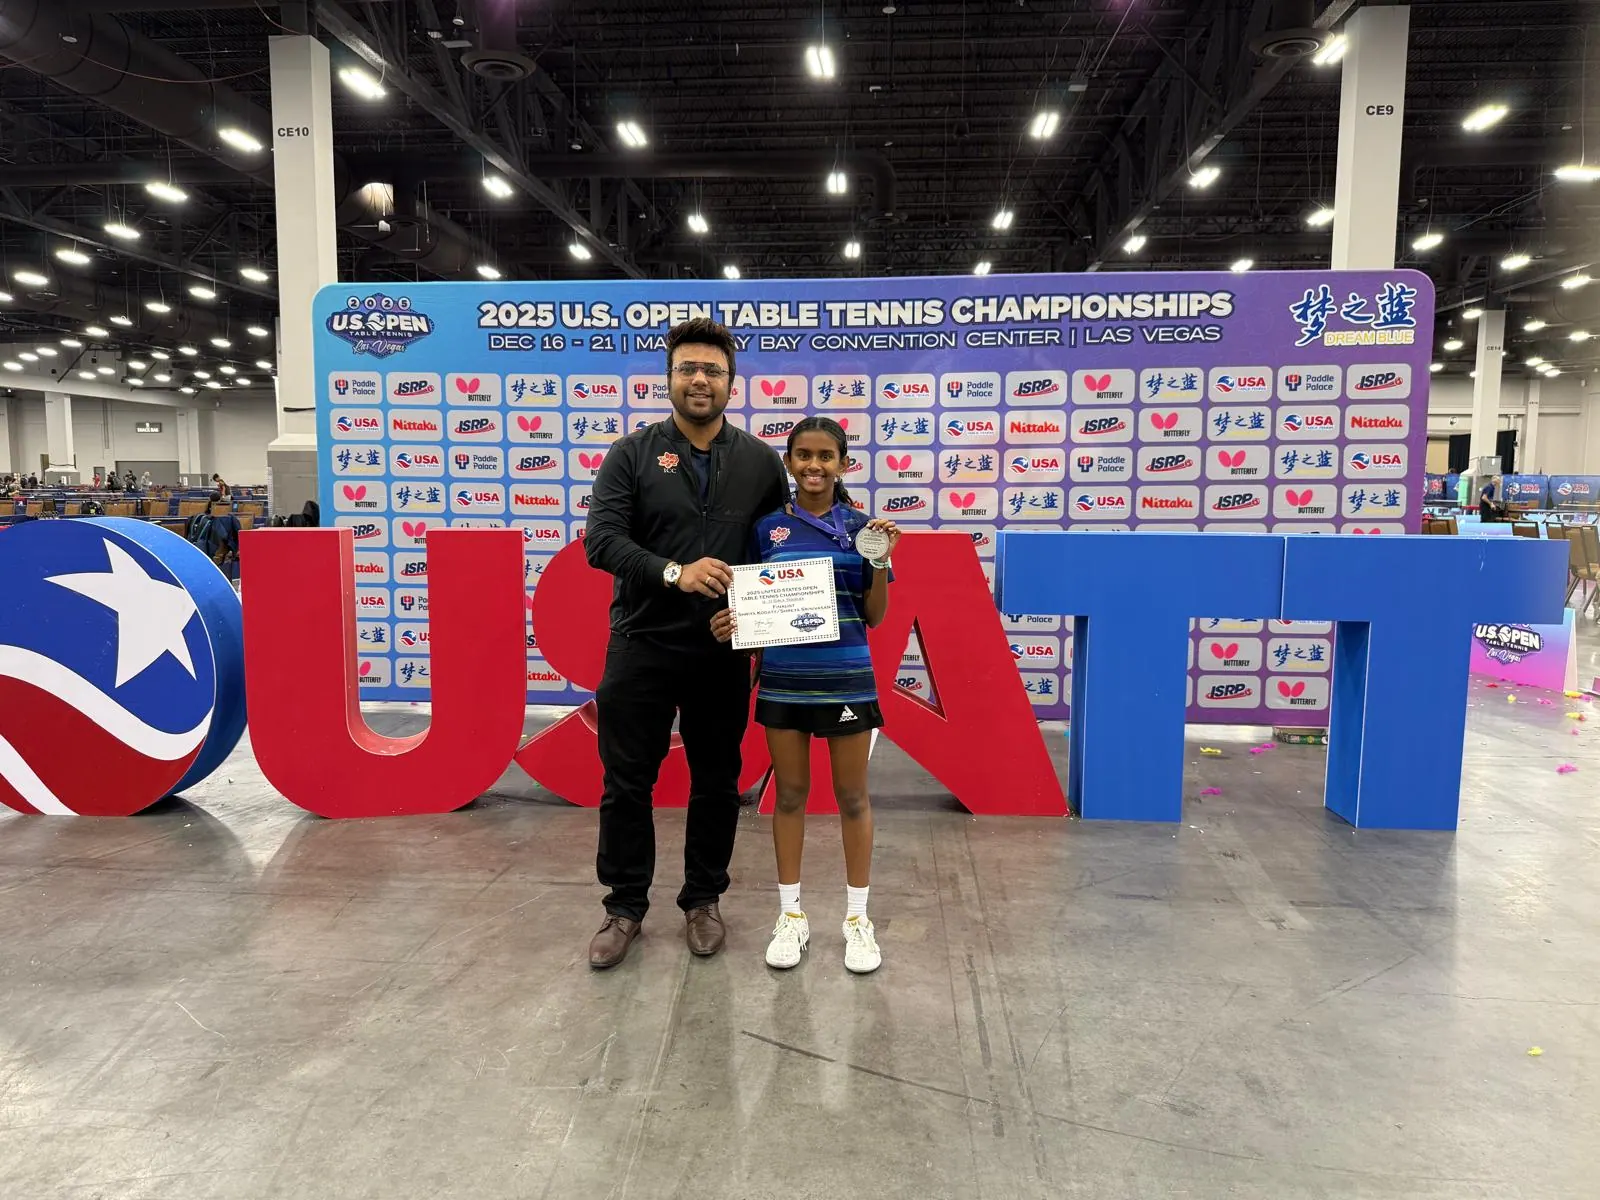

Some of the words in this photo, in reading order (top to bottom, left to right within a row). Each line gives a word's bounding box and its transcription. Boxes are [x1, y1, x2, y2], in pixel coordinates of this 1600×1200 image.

[1365, 104, 1395, 116] CE9
[277, 126, 310, 138] CE10
[479, 302, 556, 328] 2025
[561, 302, 620, 328] U.S.
[625, 302, 711, 328] OPEN
[718, 302, 820, 328] TABLE
[825, 299, 945, 327] TENNIS
[951, 291, 1234, 324] CHAMPIONSHIPS
[1290, 282, 1416, 345] 梦之蓝
[490, 335, 534, 350] DEC
[542, 335, 565, 350] 16
[592, 336, 614, 350] 21
[760, 335, 802, 350] BAY
[811, 333, 956, 350] CONVENTION
[965, 330, 1061, 347] CENTER
[1085, 327, 1133, 344] LAS
[1143, 325, 1222, 342] VEGAS
[1324, 331, 1375, 345] DREAM
[1375, 330, 1414, 344] BLUE
[353, 340, 370, 354] Las
[371, 340, 406, 354] Vegas
[1238, 377, 1265, 387] USA
[1306, 374, 1335, 382] Paddle
[1359, 371, 1396, 388] ISRP
[398, 380, 428, 393] ISRP
[510, 378, 558, 402] 梦之蓝
[591, 385, 617, 394] USA
[902, 383, 929, 394] USA
[967, 381, 993, 390] Paddle
[1018, 378, 1052, 394] ISRP
[1145, 372, 1198, 398] 梦之蓝
[1306, 383, 1333, 391] Palace
[468, 394, 491, 402] BUTTERFLY
[817, 381, 866, 405] 梦之蓝
[1096, 391, 1124, 399] BUTTERFLY
[772, 396, 798, 405] BUTTERFLY
[354, 418, 379, 427] USA
[393, 418, 436, 432] Nittaku
[458, 418, 488, 432] ISRP
[966, 421, 993, 431] USA
[1084, 416, 1119, 432] ISRP
[1213, 411, 1265, 436] 梦之蓝
[1305, 415, 1333, 426] USA
[1351, 416, 1403, 429] Nittaku
[572, 416, 617, 440] 梦之蓝
[762, 422, 794, 436] ISRP
[880, 417, 930, 441] 梦之蓝
[1010, 421, 1060, 434] Nittaku
[336, 448, 381, 472] 梦之蓝
[414, 455, 438, 464] USA
[473, 454, 498, 463] Paddle
[520, 456, 549, 468] ISRP
[1030, 457, 1060, 469] USA
[1098, 456, 1126, 464] Paddle
[1151, 454, 1186, 470] ISRP
[1280, 449, 1333, 475] 梦之蓝
[1372, 454, 1401, 464] USA
[473, 462, 498, 470] Palace
[943, 454, 993, 478] 梦之蓝
[395, 486, 441, 509] 梦之蓝
[475, 492, 499, 501] USA
[514, 494, 559, 507] Nittaku
[886, 495, 918, 510] ISRP
[1096, 496, 1125, 506] USA
[1219, 493, 1252, 508] ISRP
[1347, 488, 1401, 514] 梦之蓝
[1009, 491, 1059, 516] 梦之蓝
[1142, 497, 1192, 509] Nittaku
[961, 508, 987, 516] BUTTERFLY
[1298, 506, 1325, 514] BUTTERFLY
[535, 529, 560, 538] USA
[777, 568, 805, 579] USA
[360, 597, 385, 605] USA
[1026, 615, 1053, 623] Palace
[1485, 638, 1505, 647] TABLE
[1498, 625, 1541, 650] OPEN
[1025, 646, 1053, 656] USA
[1272, 643, 1325, 668] 梦之蓝
[1223, 659, 1251, 667] BUTTERFLY
[358, 677, 381, 685] BUTTERFLY
[1208, 683, 1246, 697] ISRP
